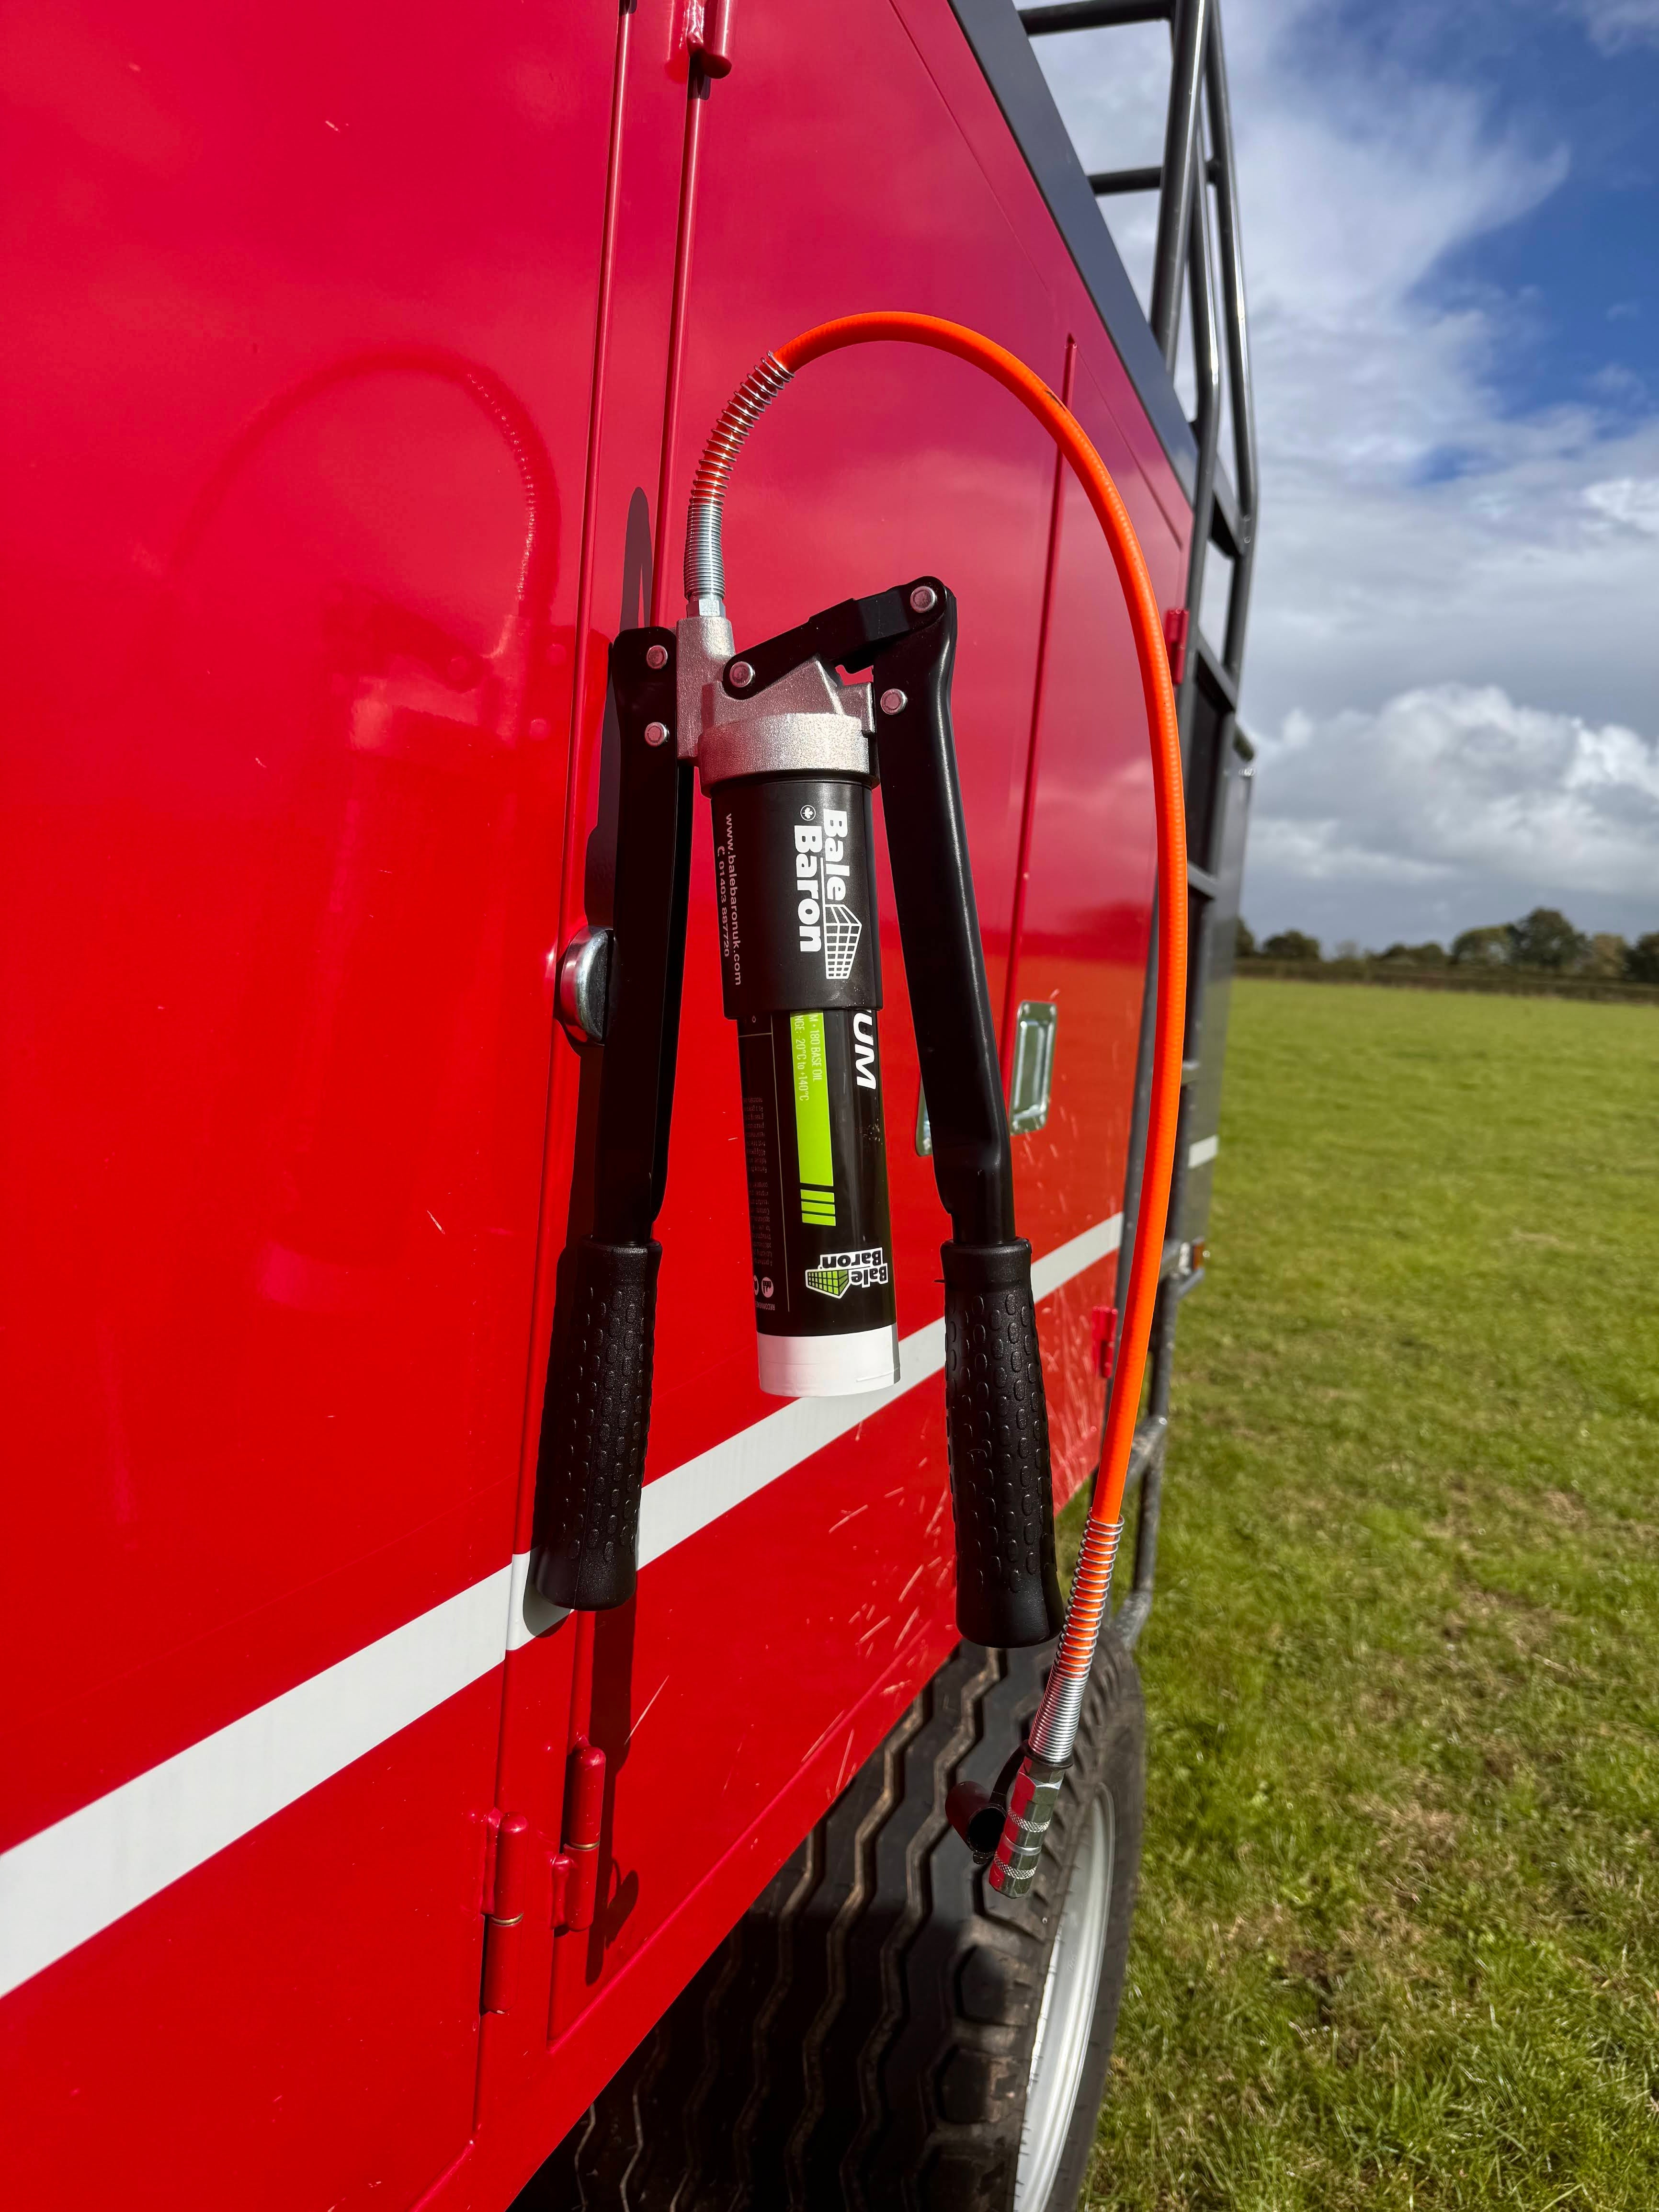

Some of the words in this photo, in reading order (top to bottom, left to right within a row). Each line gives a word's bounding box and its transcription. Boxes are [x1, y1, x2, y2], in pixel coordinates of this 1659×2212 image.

[823, 809, 851, 901] Bale
[726, 813, 741, 985] www.balebaronuk.com
[794, 825, 823, 953] Baron
[810, 1029, 820, 1045] 180
[811, 1047, 822, 1067] BASE
[853, 1010, 876, 1090] UM
[812, 1069, 822, 1083] OIL
[822, 1250, 882, 1269] Baron
[851, 1266, 887, 1285] Bale
